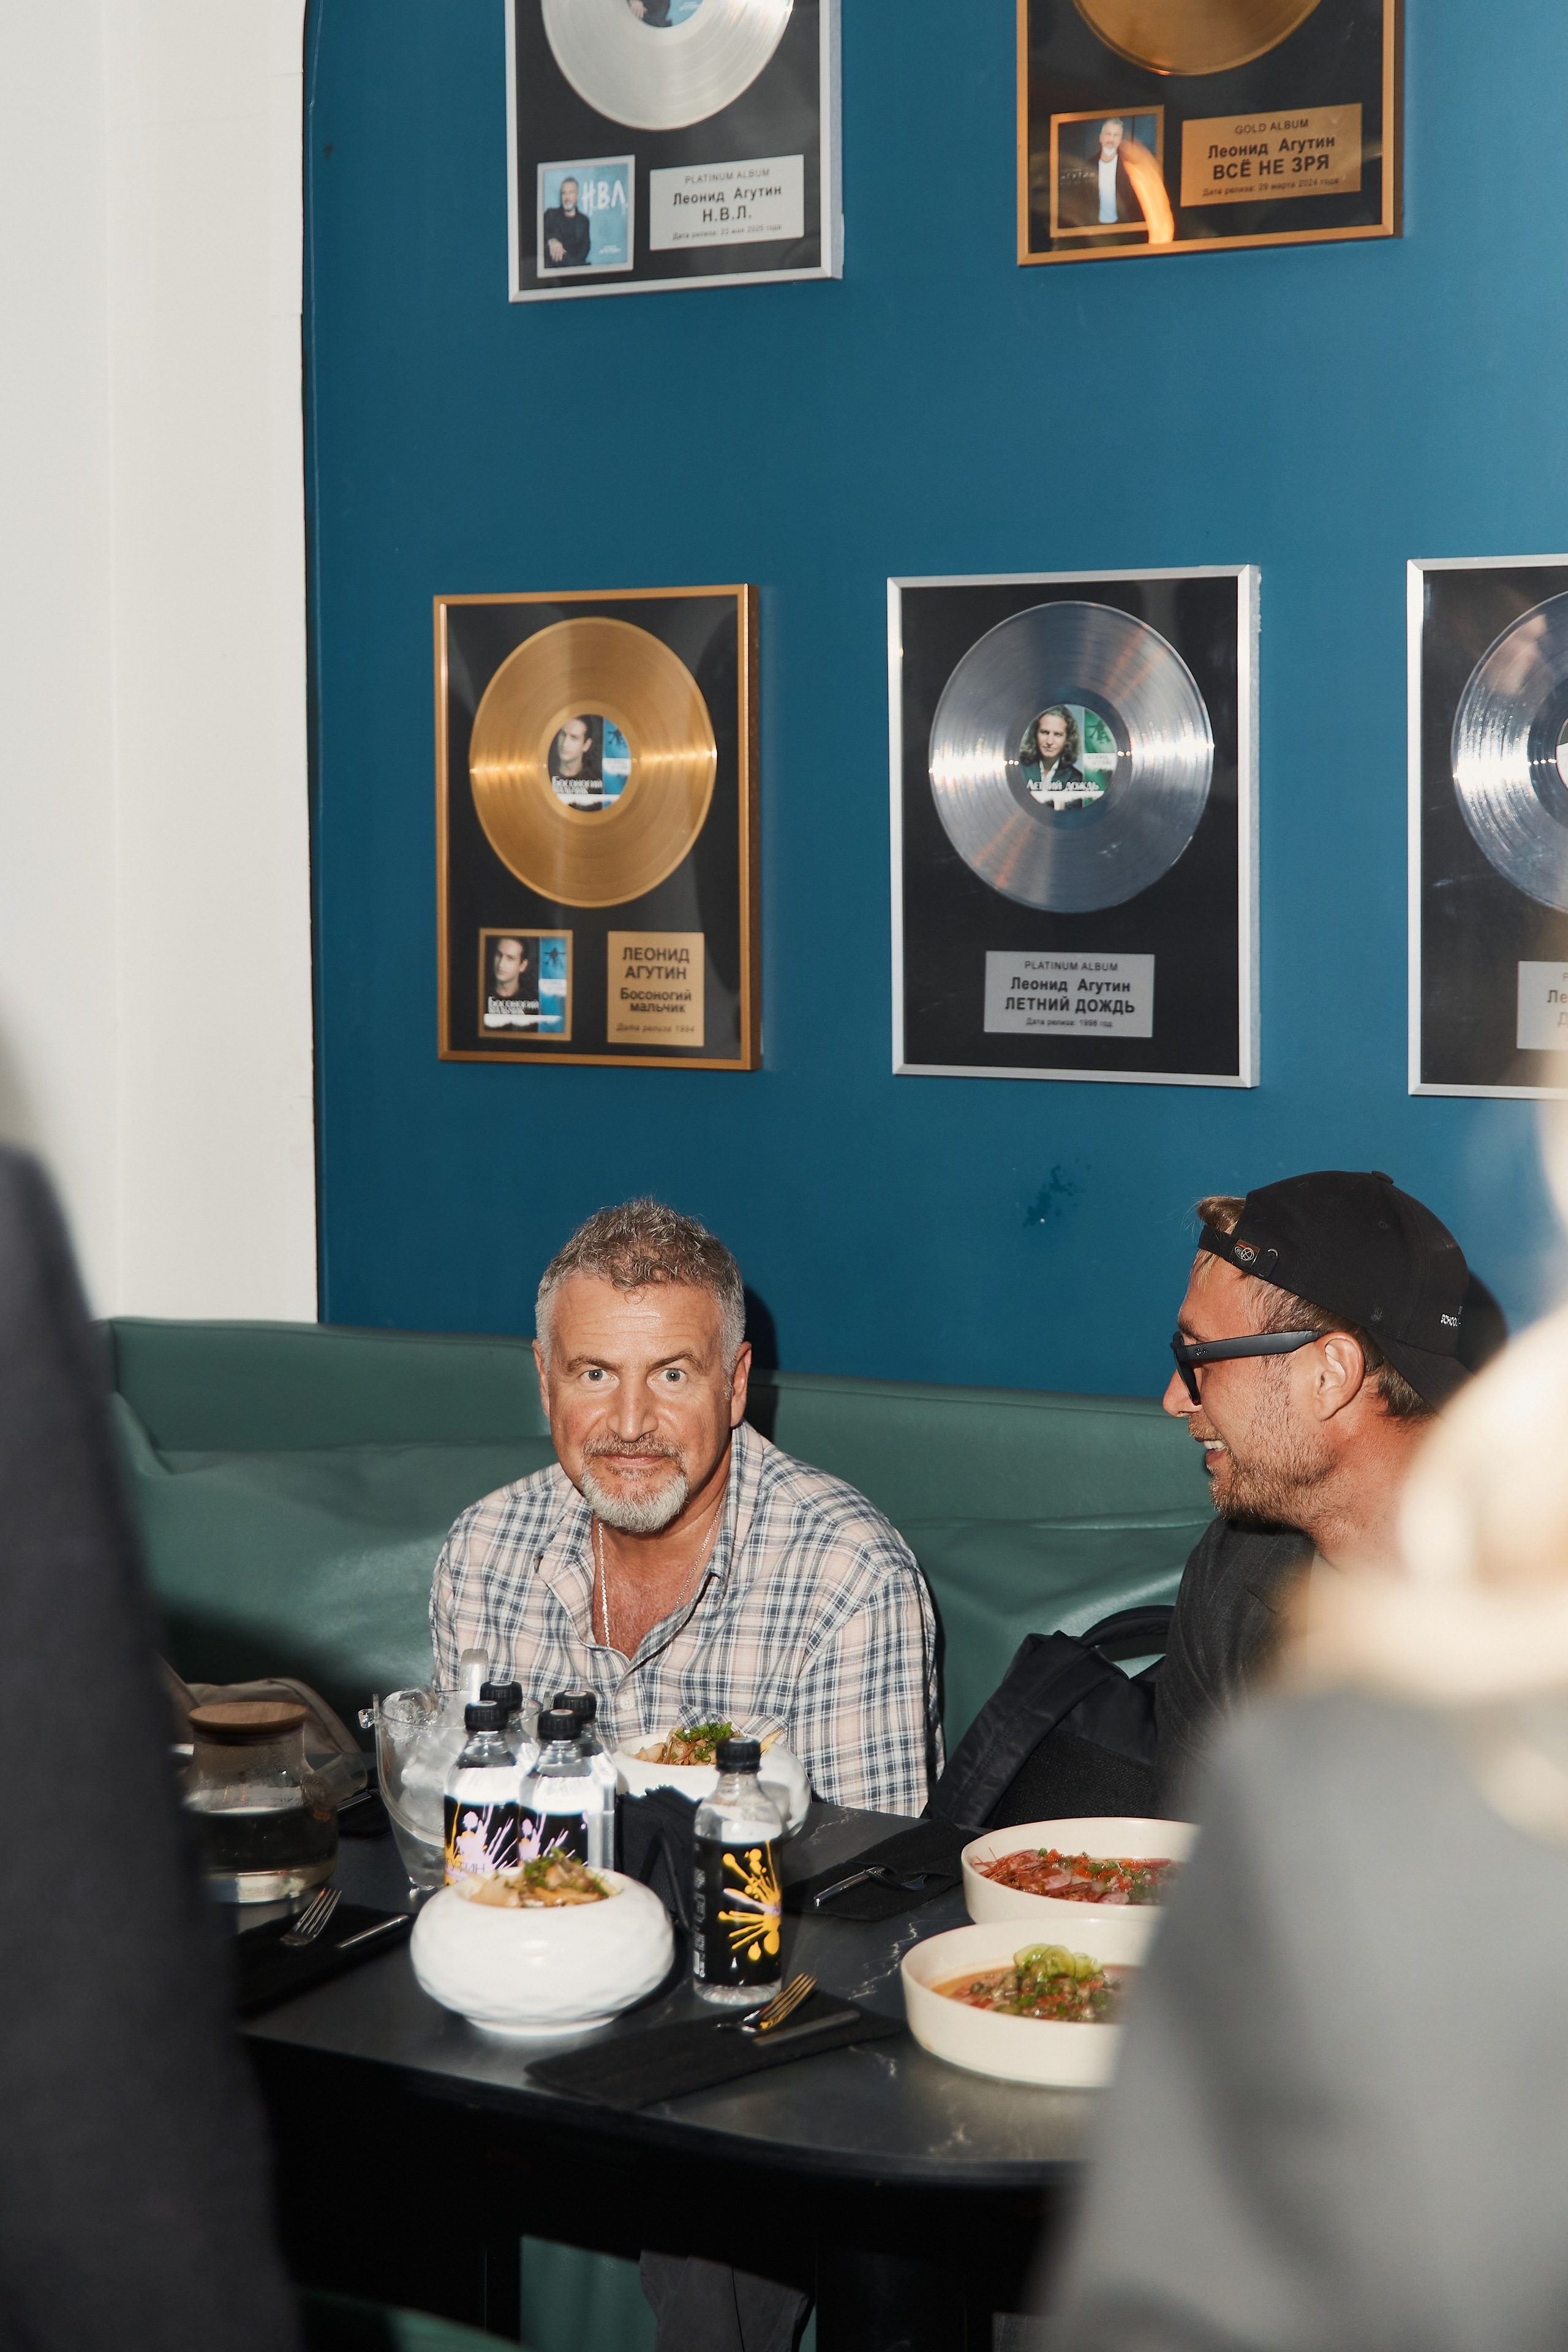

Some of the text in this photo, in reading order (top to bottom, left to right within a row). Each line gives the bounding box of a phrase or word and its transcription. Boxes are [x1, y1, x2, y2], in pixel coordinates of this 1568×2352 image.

[1235, 118, 1309, 134] GOLD ALBUM
[1208, 137, 1335, 159] Леонид Агутин
[1213, 154, 1330, 180] ВСЁ НЕ ЗРЯ
[685, 168, 771, 184] PLATINUM ALBUM
[673, 186, 782, 205] Леонид Агутин
[703, 205, 752, 222] Н.В.Л.
[622, 947, 690, 963] ЛЕОНИД
[625, 965, 687, 979] АГУТИН
[1024, 960, 1118, 971] PLATINUM ALBUM
[1011, 976, 1131, 994] Леонид Агутин
[620, 987, 692, 1001] Босоногий
[630, 1002, 685, 1012] мальчик
[1005, 996, 1135, 1015] ЛЕТНИЙ ДОЖДЬ
[445, 1858, 484, 1874] ГУТИН
